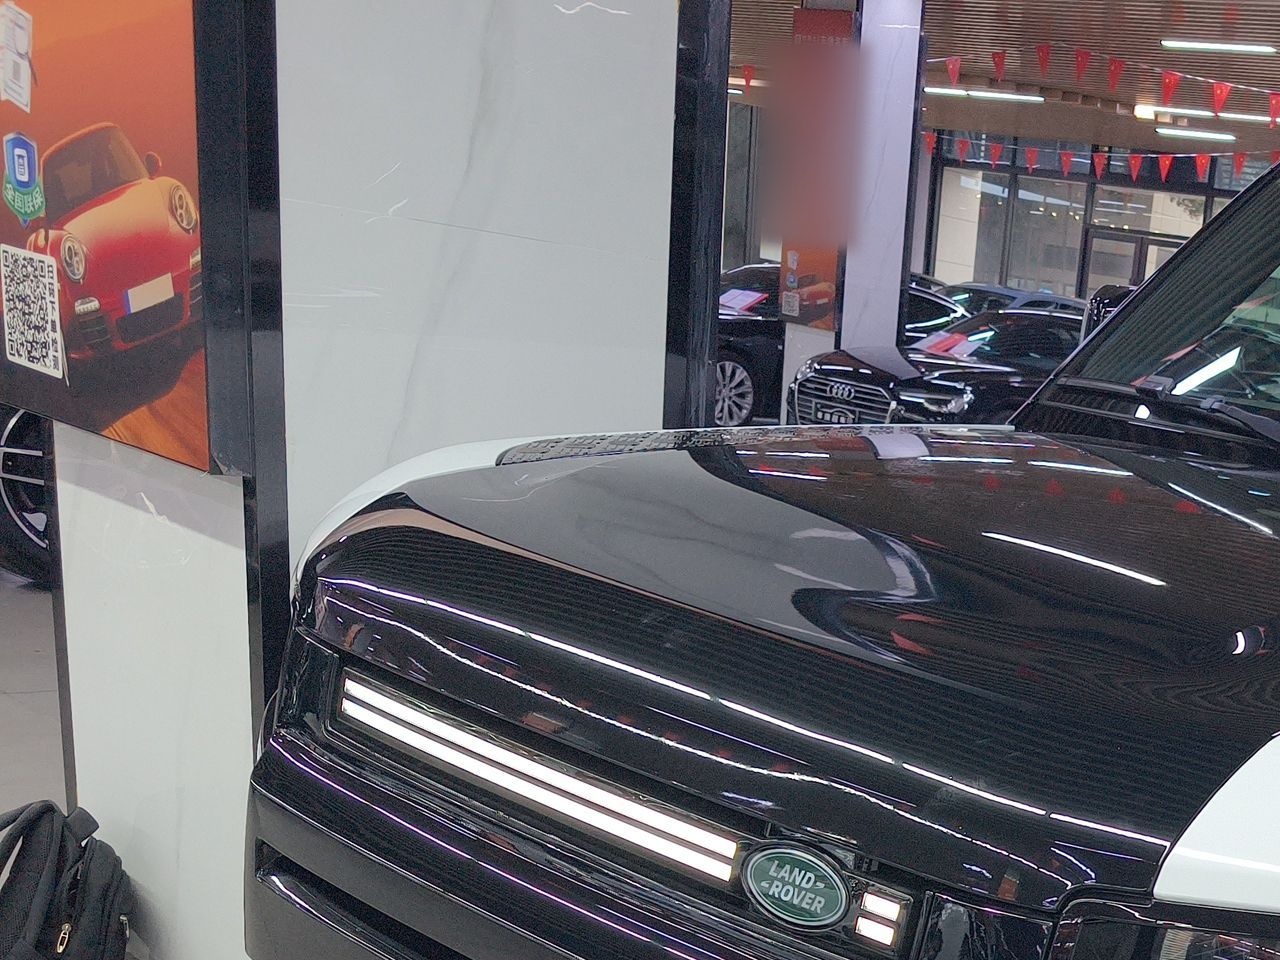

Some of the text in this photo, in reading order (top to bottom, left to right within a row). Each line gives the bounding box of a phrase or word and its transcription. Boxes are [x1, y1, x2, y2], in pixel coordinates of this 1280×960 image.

[5, 183, 43, 214] 全国联保
[768, 859, 817, 889] LAND
[768, 881, 826, 914] ROVER
